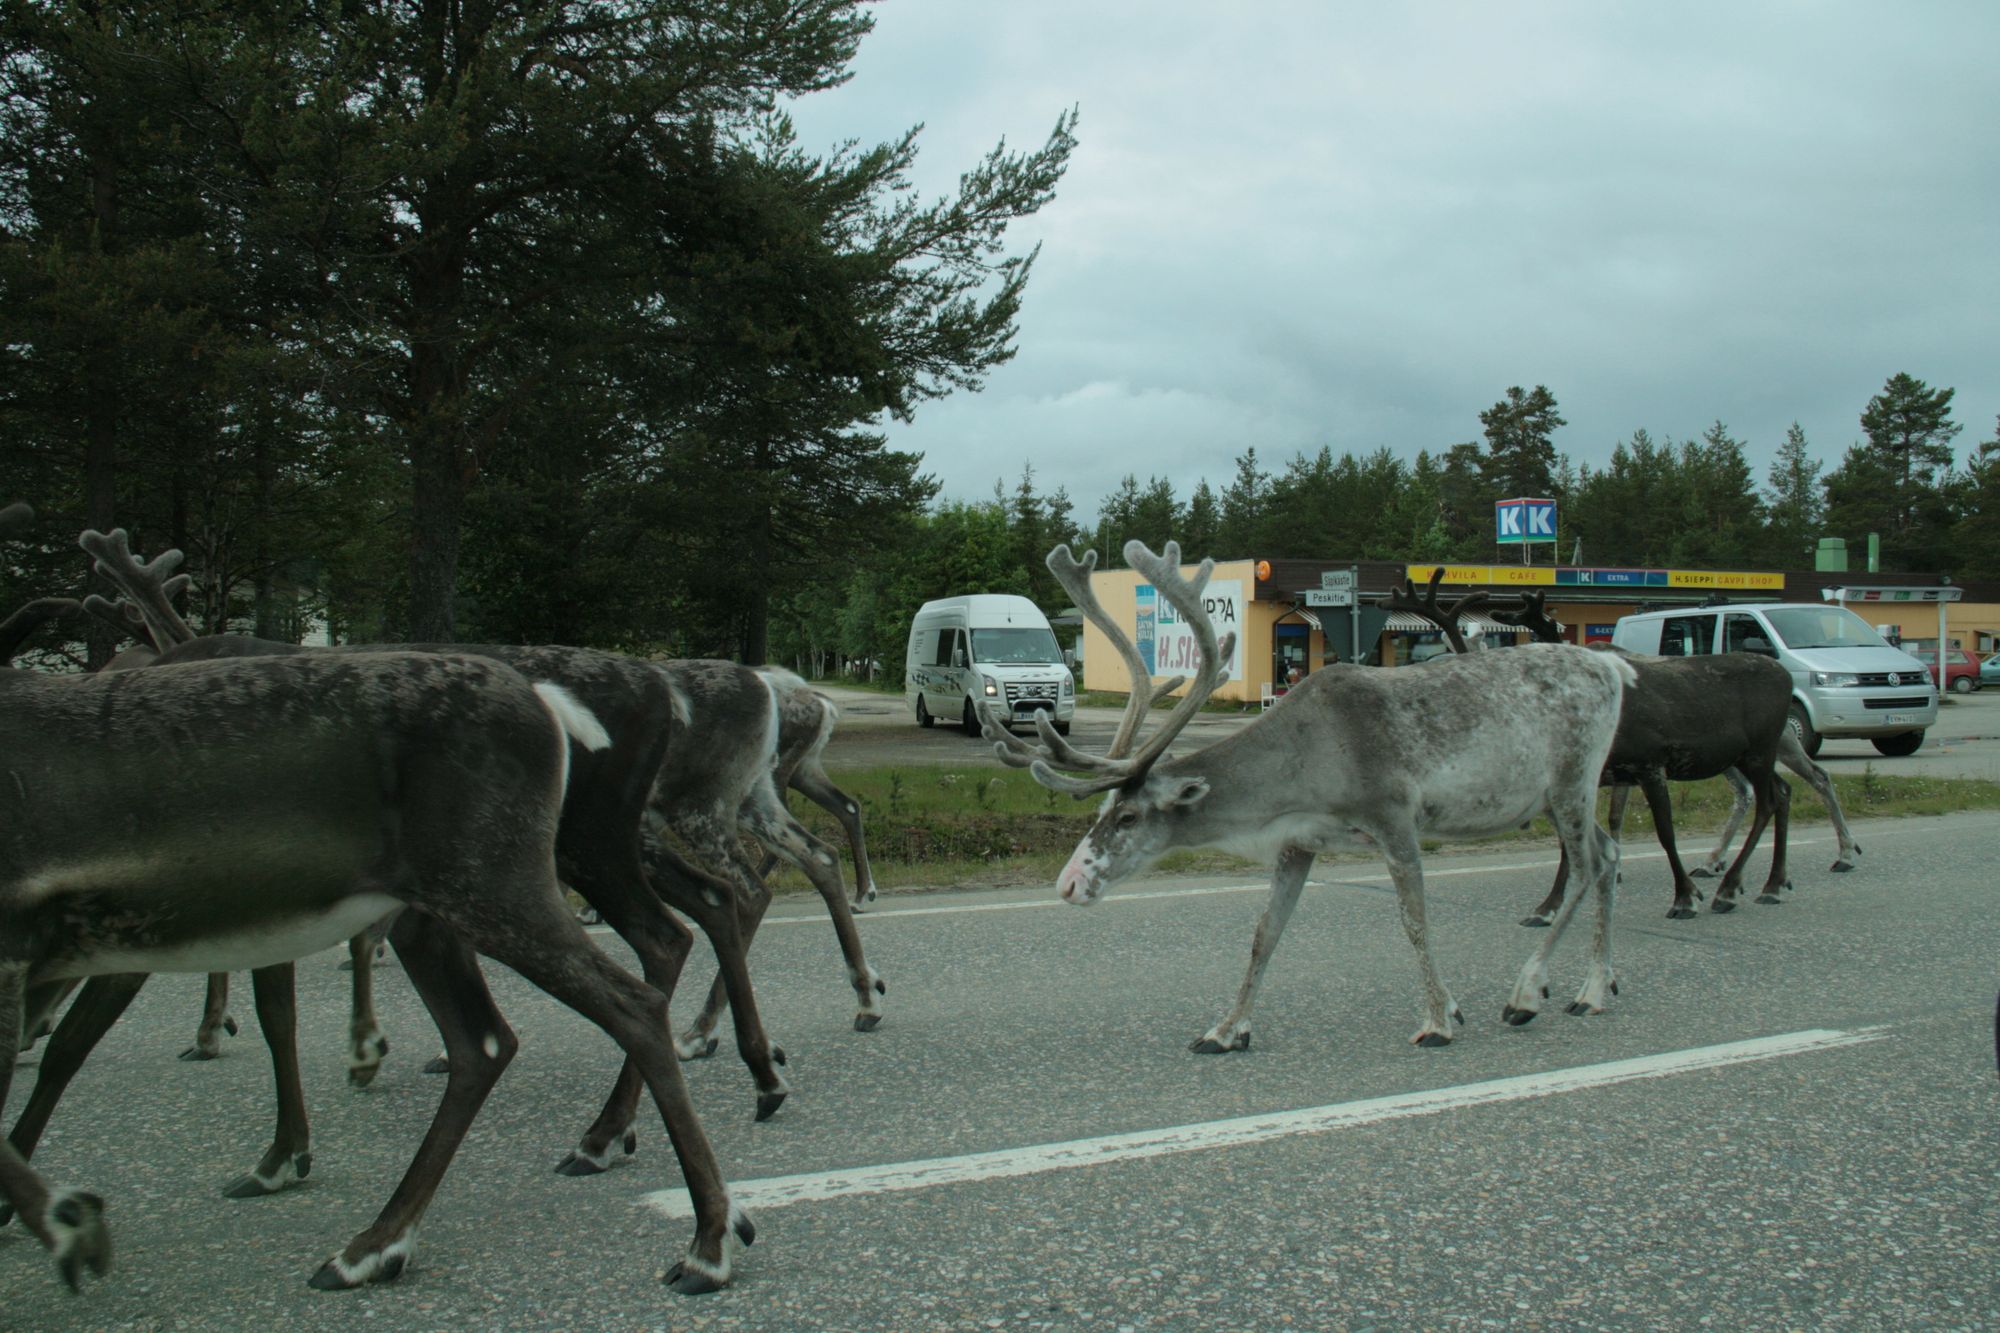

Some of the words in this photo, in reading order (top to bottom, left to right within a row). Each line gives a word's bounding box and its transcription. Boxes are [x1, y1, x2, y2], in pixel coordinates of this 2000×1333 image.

[1500, 507, 1520, 535] K
[1529, 506, 1552, 534] K
[1427, 570, 1477, 580] KHVILA
[1509, 571, 1537, 580] CAFE
[1580, 571, 1590, 582] K
[1607, 574, 1630, 582] EXTRA
[1684, 576, 1713, 584] SIEPPI
[1750, 576, 1773, 585] SHOP
[1313, 593, 1345, 602] Peskitie
